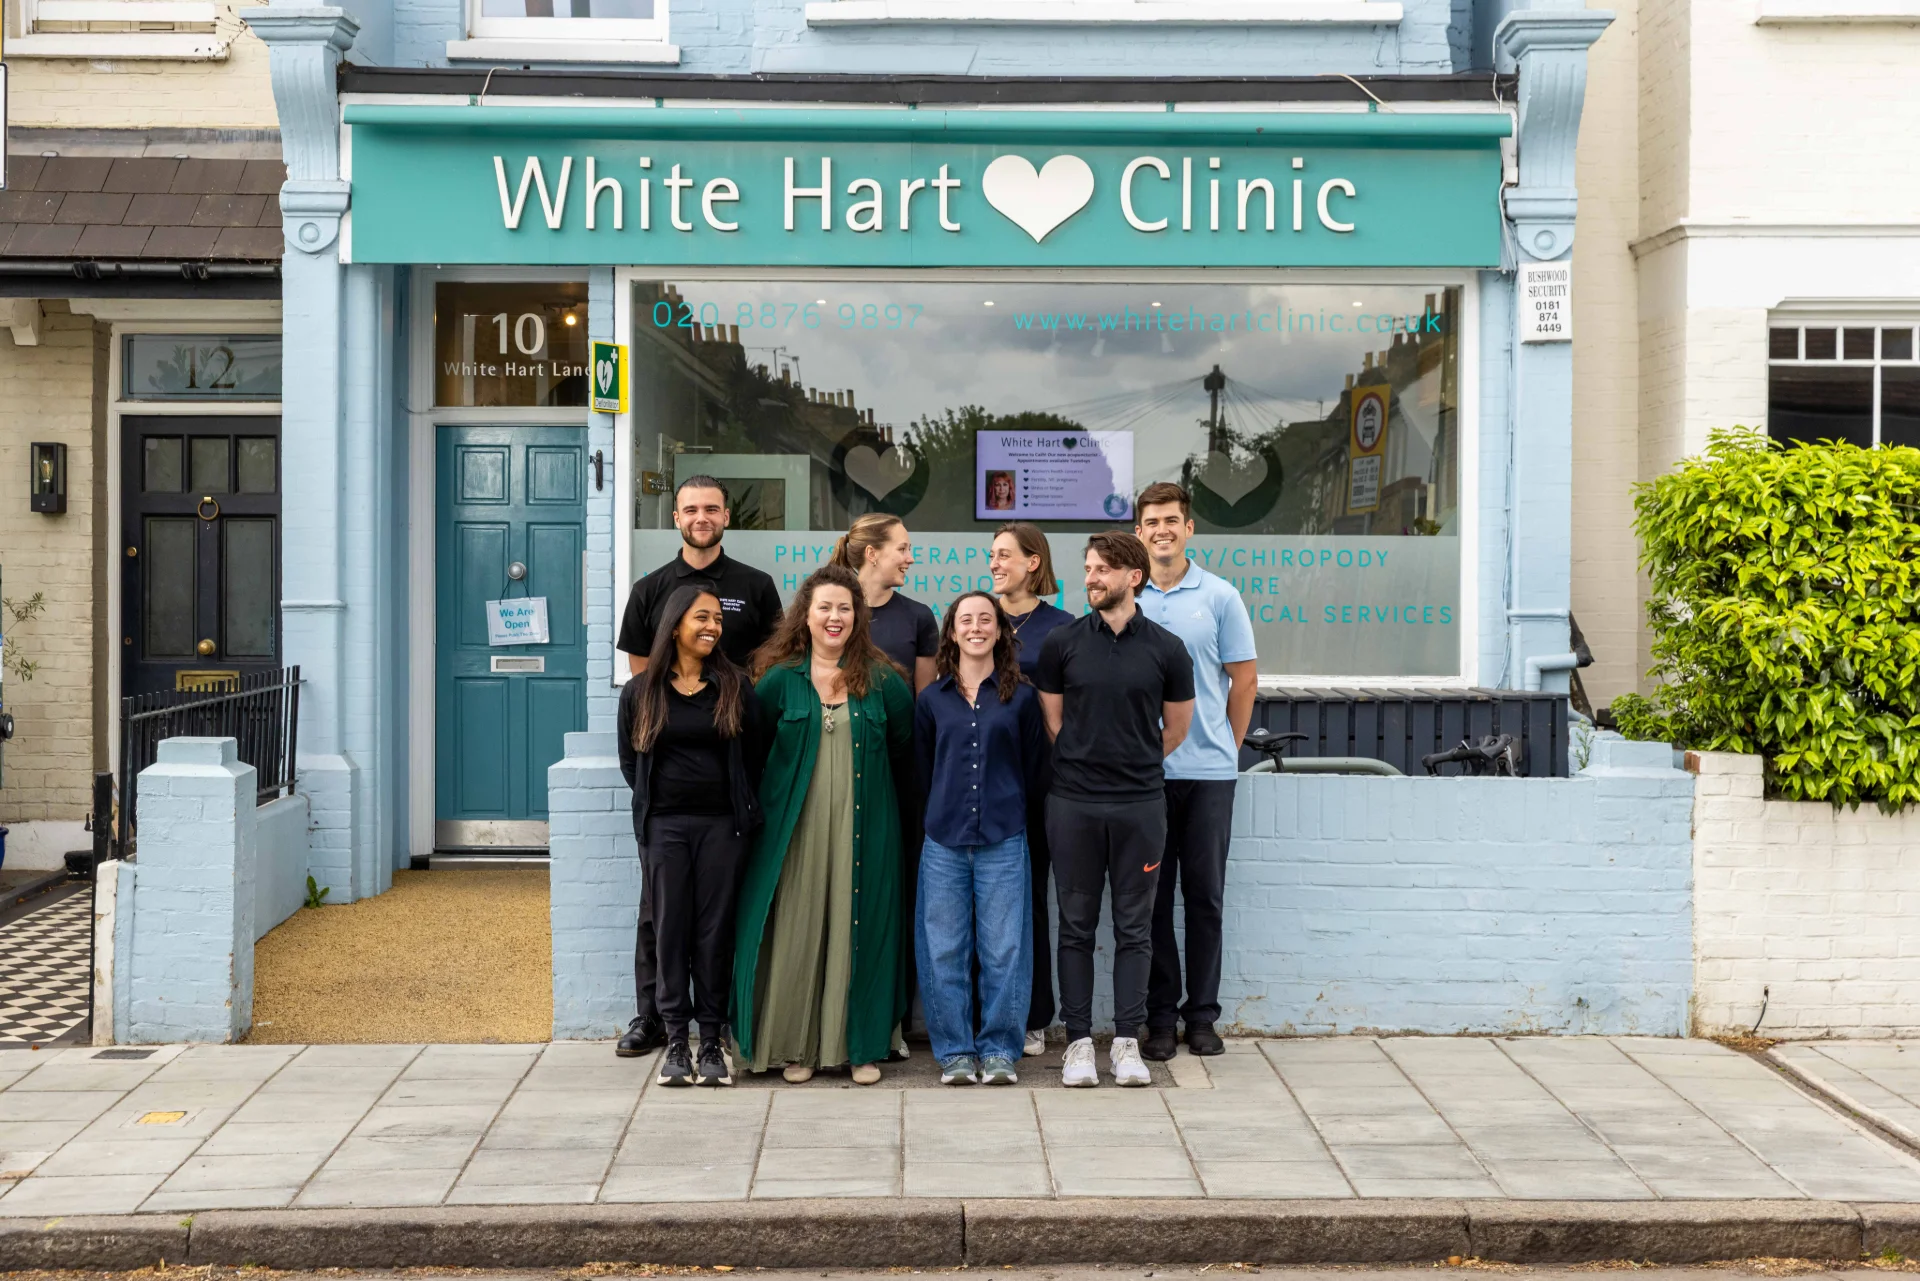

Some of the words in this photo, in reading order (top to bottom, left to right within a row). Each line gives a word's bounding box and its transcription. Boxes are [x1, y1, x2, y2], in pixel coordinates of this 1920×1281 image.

[493, 155, 740, 231] White
[784, 156, 961, 232] Hart
[1119, 155, 1356, 233] Clinic
[1527, 270, 1568, 283] BUSHWOOD
[1528, 285, 1567, 297] SECURITY
[1535, 301, 1560, 310] 0181
[652, 301, 719, 328] 020
[736, 302, 821, 329] 8876
[837, 303, 925, 330] 9897
[1013, 304, 1441, 333] www.whitehartclinic.co.uk
[1539, 312, 1558, 321] 874
[492, 312, 545, 355] 10
[1536, 323, 1562, 332] 4449
[185, 345, 237, 389] 12
[444, 361, 497, 377] White
[505, 362, 544, 377] Hart
[1001, 436, 1033, 448] White
[1037, 437, 1061, 448] Hart
[1079, 437, 1110, 448] Clinic
[499, 608, 514, 617] We
[516, 607, 534, 616] Are
[1324, 605, 1453, 624] SERVICES
[504, 620, 530, 630] Open
